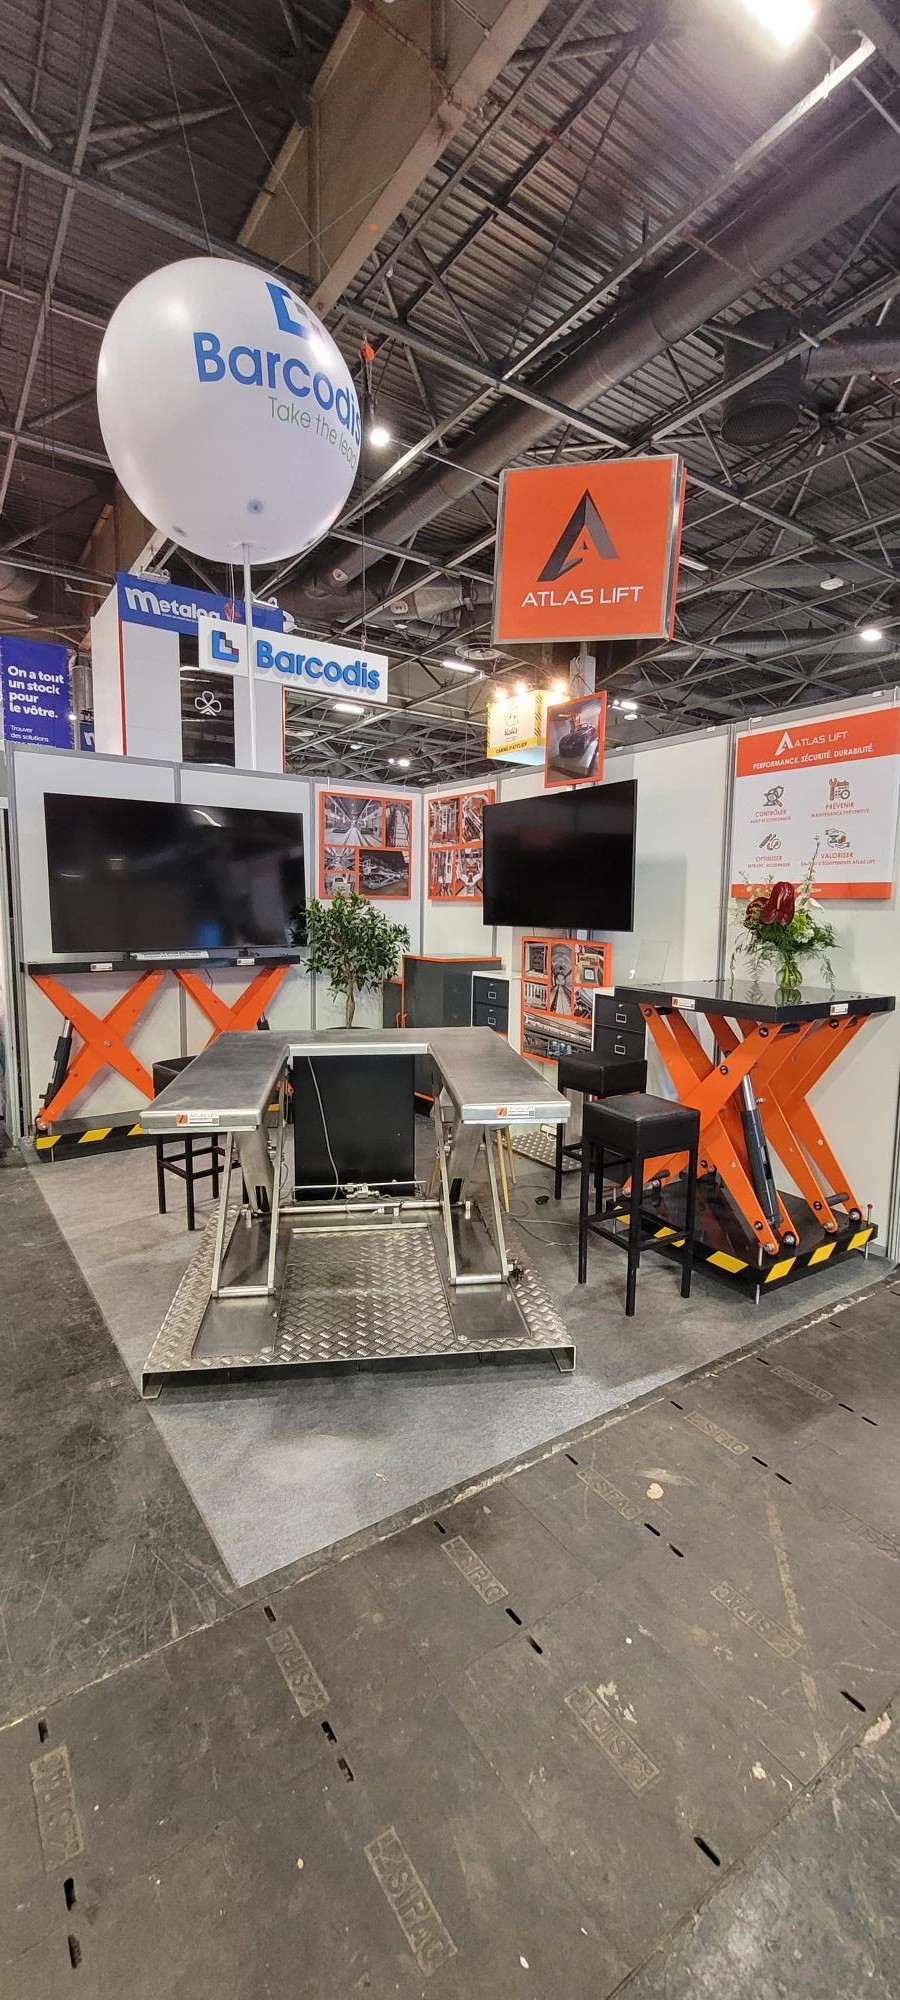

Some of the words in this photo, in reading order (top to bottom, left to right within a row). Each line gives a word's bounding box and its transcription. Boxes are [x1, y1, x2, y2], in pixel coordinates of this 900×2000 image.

[193, 331, 361, 446] Barcodis
[268, 396, 311, 428] Take
[316, 414, 337, 444] the
[521, 589, 594, 607] ATLAS
[600, 586, 644, 604] LIFT
[257, 639, 380, 690] Barcodis
[8, 665, 27, 678] On
[29, 671, 36, 679] a
[38, 670, 64, 684] tout
[8, 680, 25, 690] un
[27, 682, 60, 695] stock
[9, 691, 39, 703] pour
[9, 702, 21, 713] le
[23, 704, 58, 718] vôtre.
[10, 725, 33, 733] Trouver
[22, 733, 49, 742] solutions
[794, 735, 825, 748] ATLAS
[828, 731, 848, 742] LIFT
